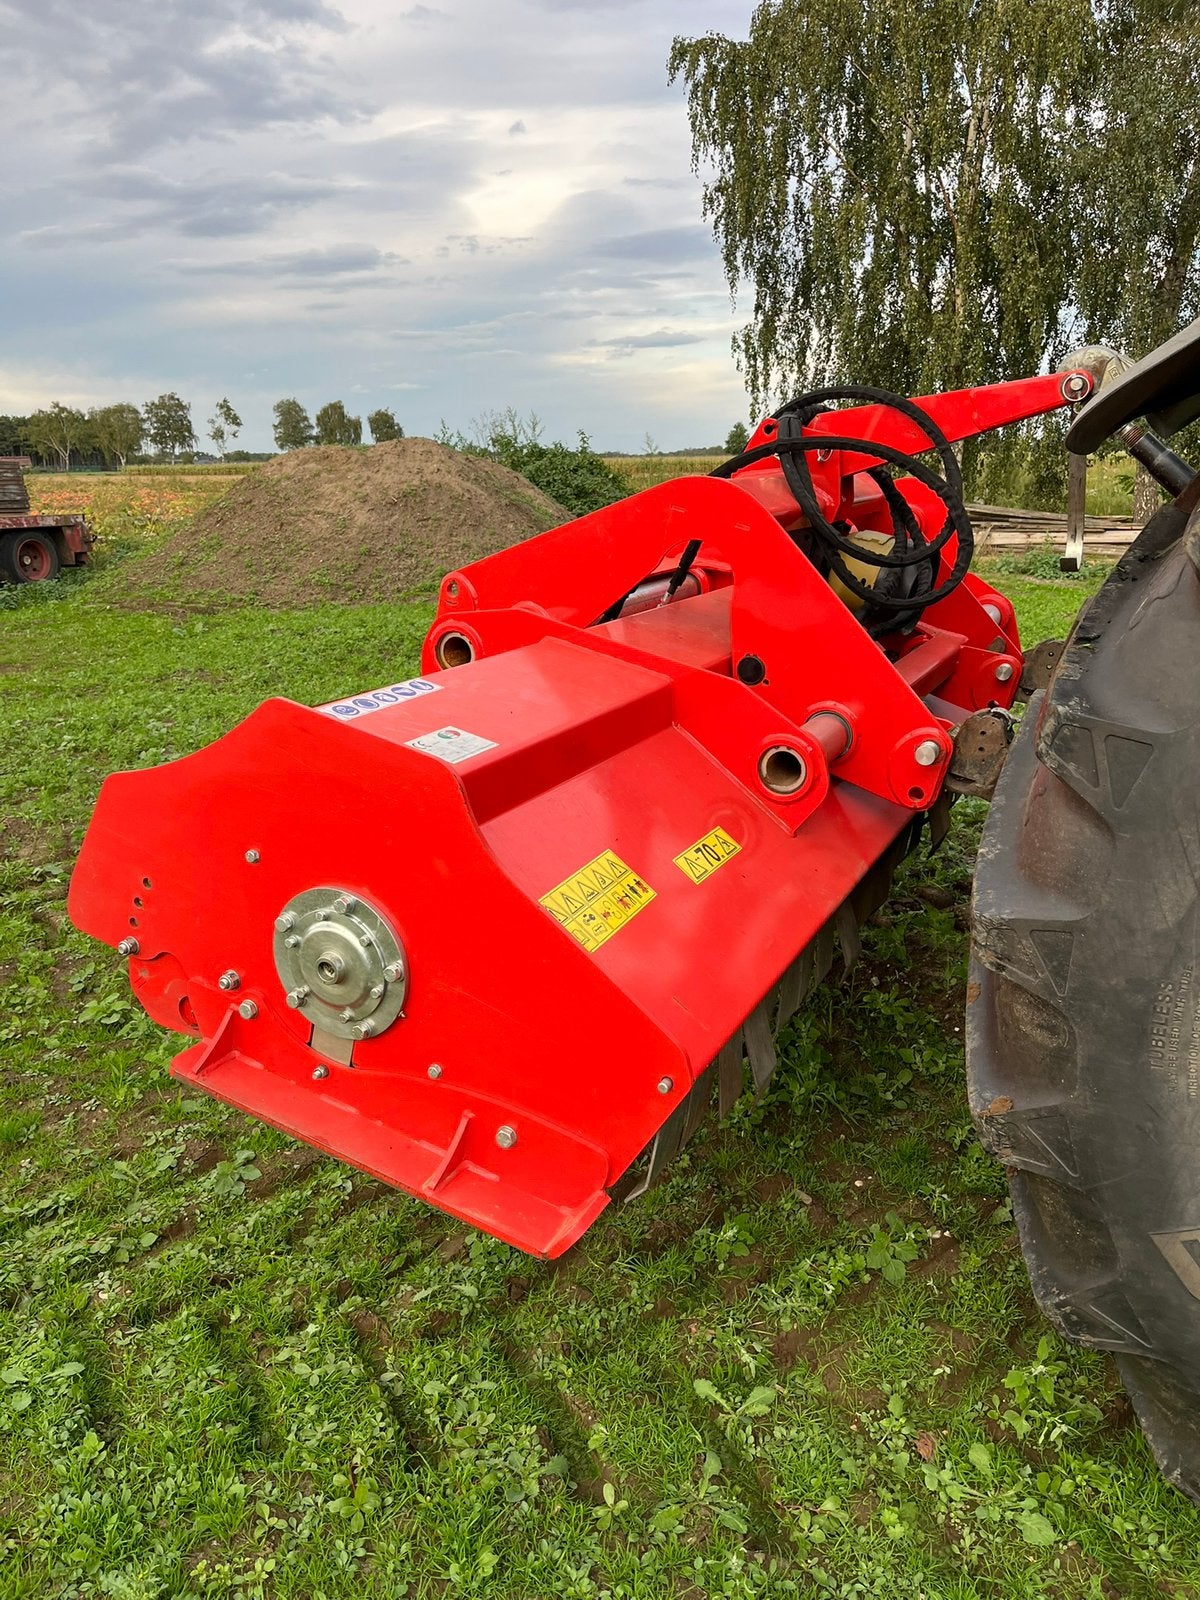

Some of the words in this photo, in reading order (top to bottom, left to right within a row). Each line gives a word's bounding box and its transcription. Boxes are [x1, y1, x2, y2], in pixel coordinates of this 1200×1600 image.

[694, 843, 721, 867] 70
[1178, 965, 1194, 992] TUBE
[1172, 996, 1186, 1023] WITH
[1150, 982, 1174, 1068] TUBELESS
[1169, 1026, 1180, 1052] USED
[1168, 1056, 1178, 1068] BE
[1187, 1042, 1199, 1098] DIRECTION
